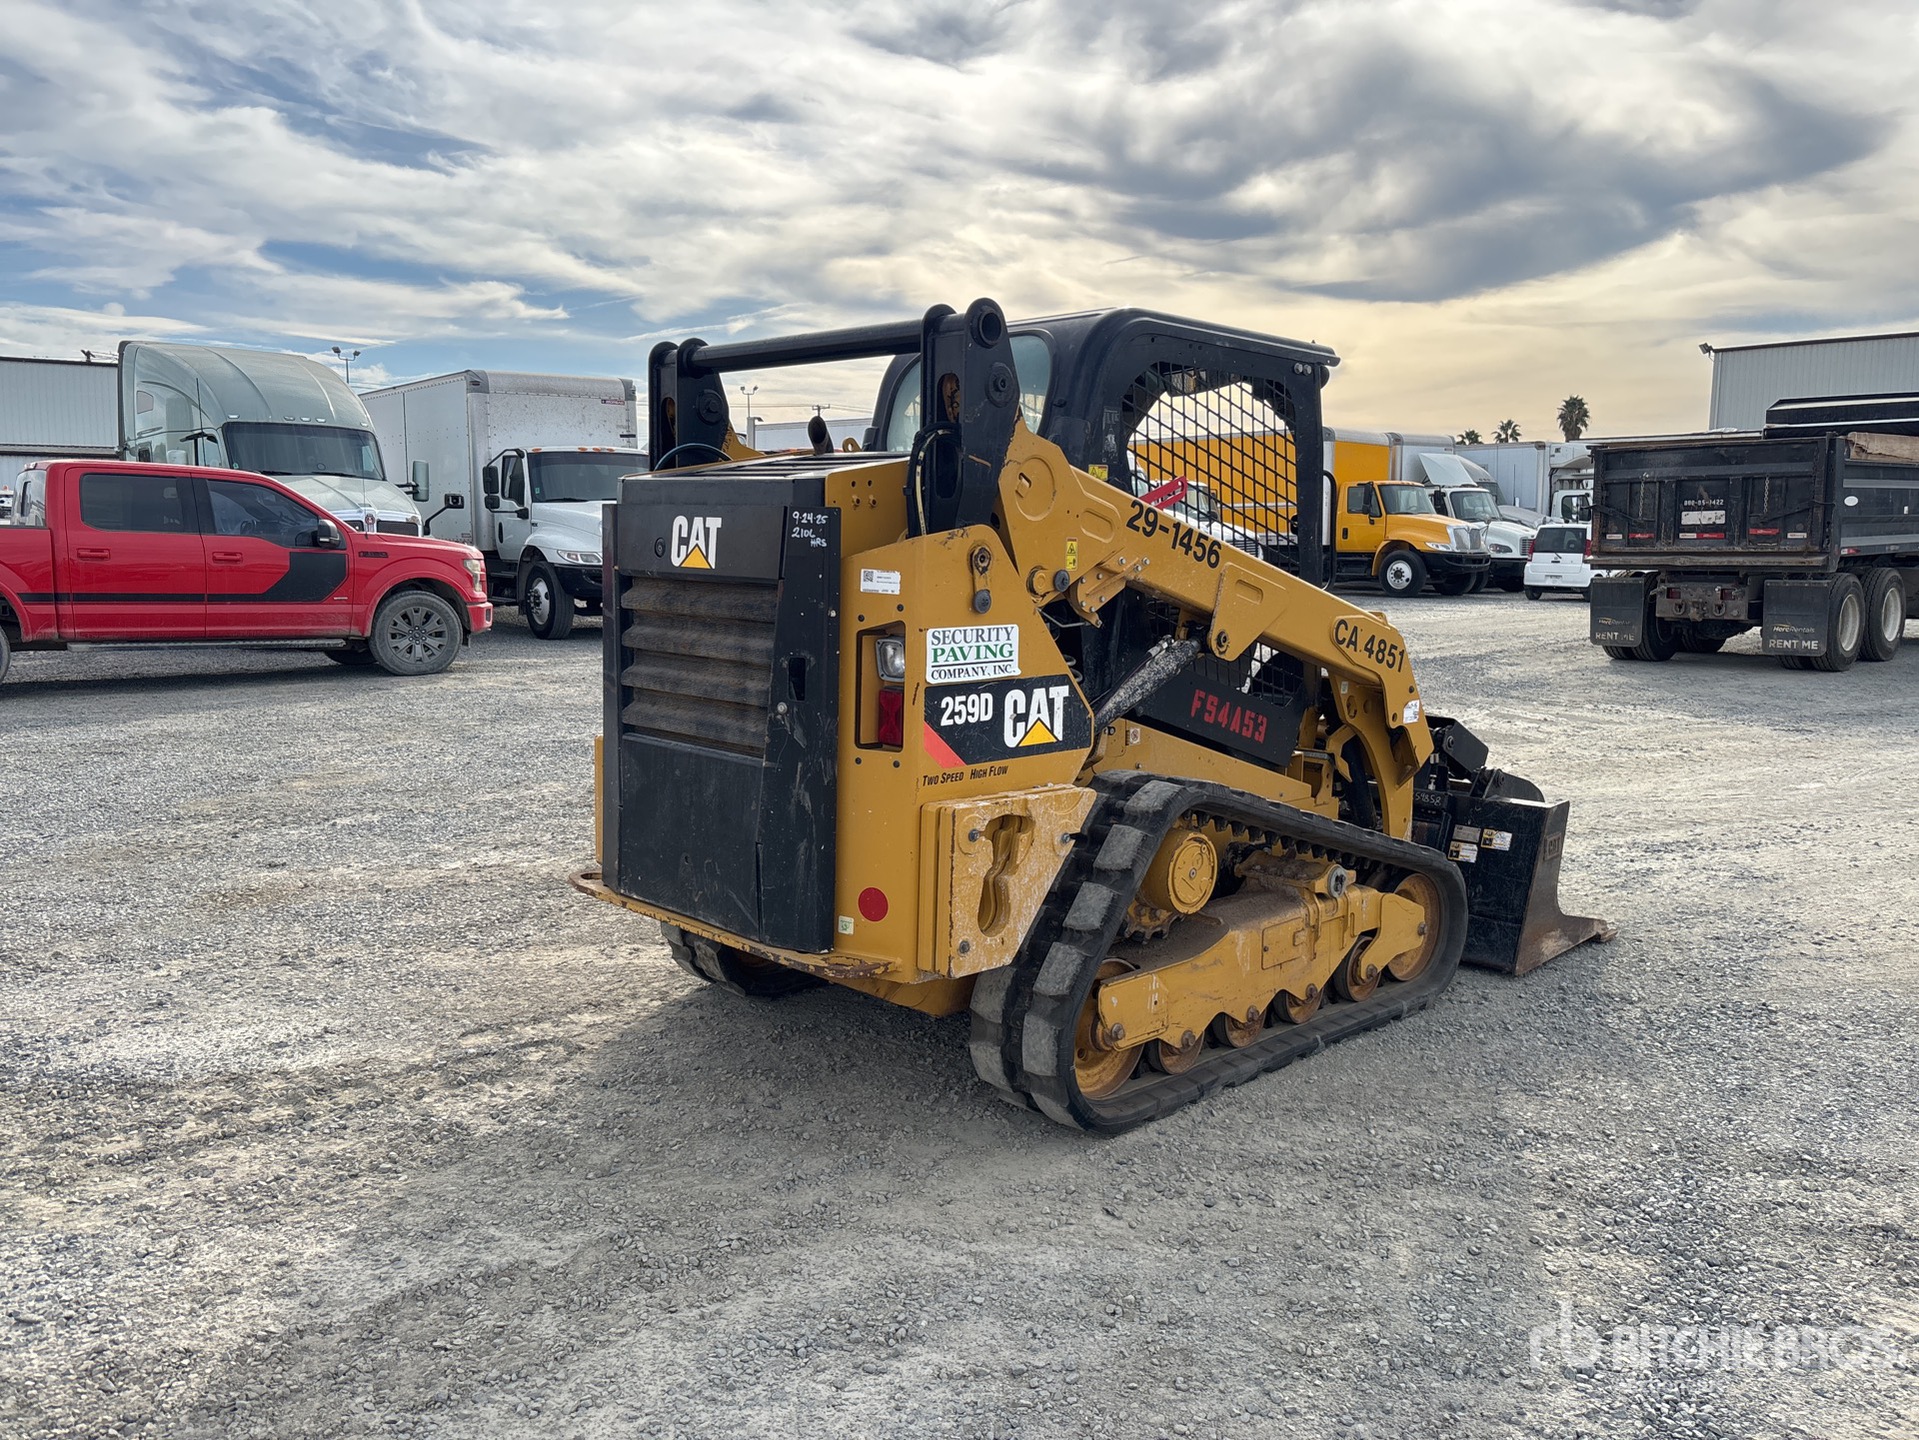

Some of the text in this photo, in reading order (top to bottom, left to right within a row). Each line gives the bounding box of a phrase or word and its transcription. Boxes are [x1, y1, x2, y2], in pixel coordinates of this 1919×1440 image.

[671, 515, 722, 570] CAT
[810, 537, 827, 548] HRS
[1126, 500, 1222, 569] 29-1456
[931, 626, 1015, 646] SECURITY
[1335, 619, 1405, 673] CA 4851
[1595, 632, 1619, 640] RENT
[1769, 639, 1819, 650] RENT ME
[931, 643, 1014, 663] PAVING
[931, 663, 1016, 680] COMPANY, INC.
[940, 685, 1069, 748] 259D CAT
